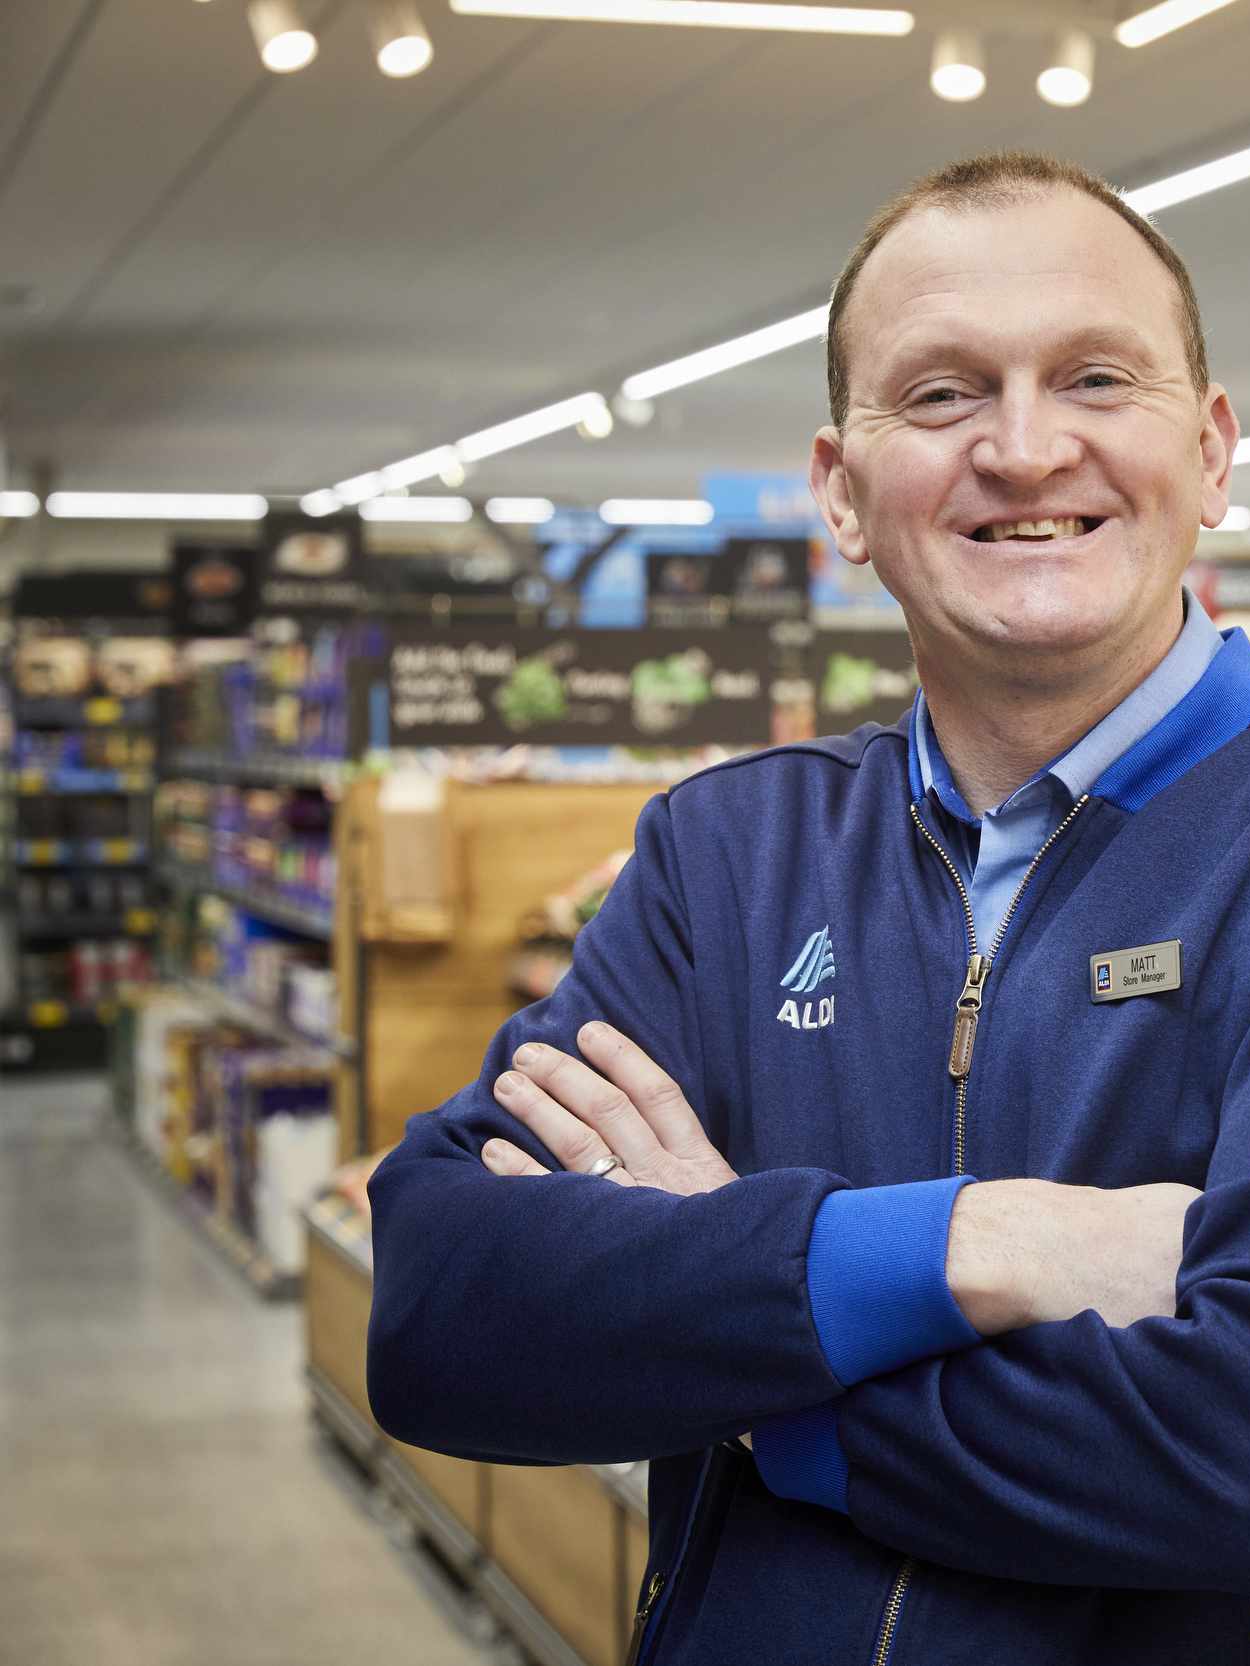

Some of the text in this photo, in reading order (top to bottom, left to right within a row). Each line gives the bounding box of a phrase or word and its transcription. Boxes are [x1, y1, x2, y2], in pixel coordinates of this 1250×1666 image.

[1130, 955, 1157, 973] MATT
[1122, 971, 1166, 986] Store Manager
[777, 995, 835, 1029] ALDI
